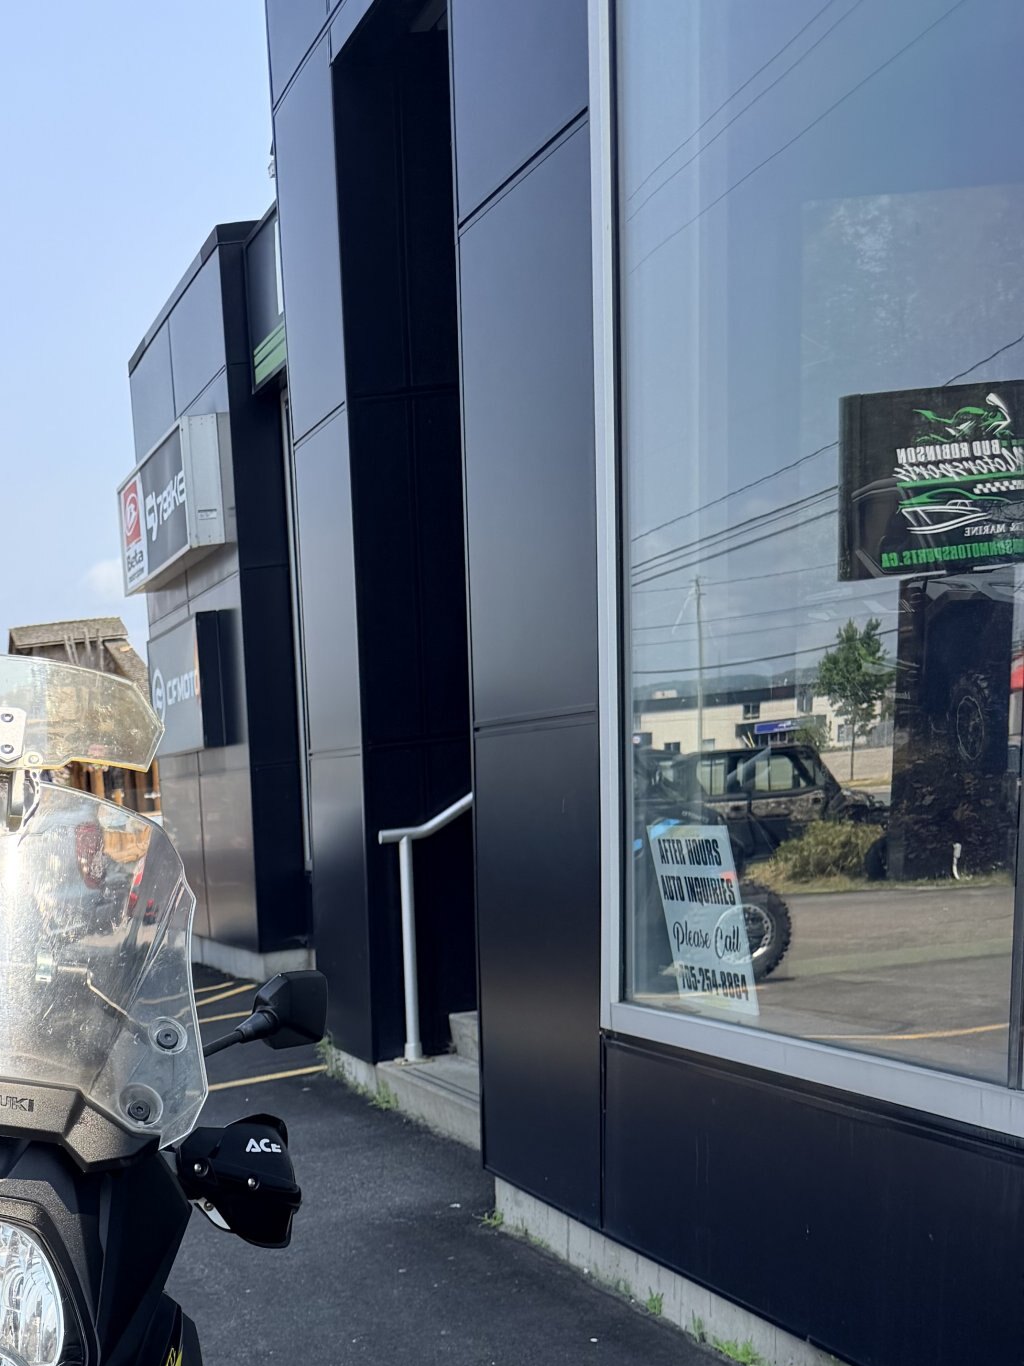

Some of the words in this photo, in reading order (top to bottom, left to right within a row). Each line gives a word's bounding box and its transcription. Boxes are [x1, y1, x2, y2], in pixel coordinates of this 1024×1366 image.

[657, 838, 686, 866] AFTER
[687, 838, 723, 867] HOURS
[660, 874, 686, 901] AUTO
[686, 877, 737, 907] INQUIRIES
[673, 920, 711, 953] Please
[714, 924, 742, 960] Call
